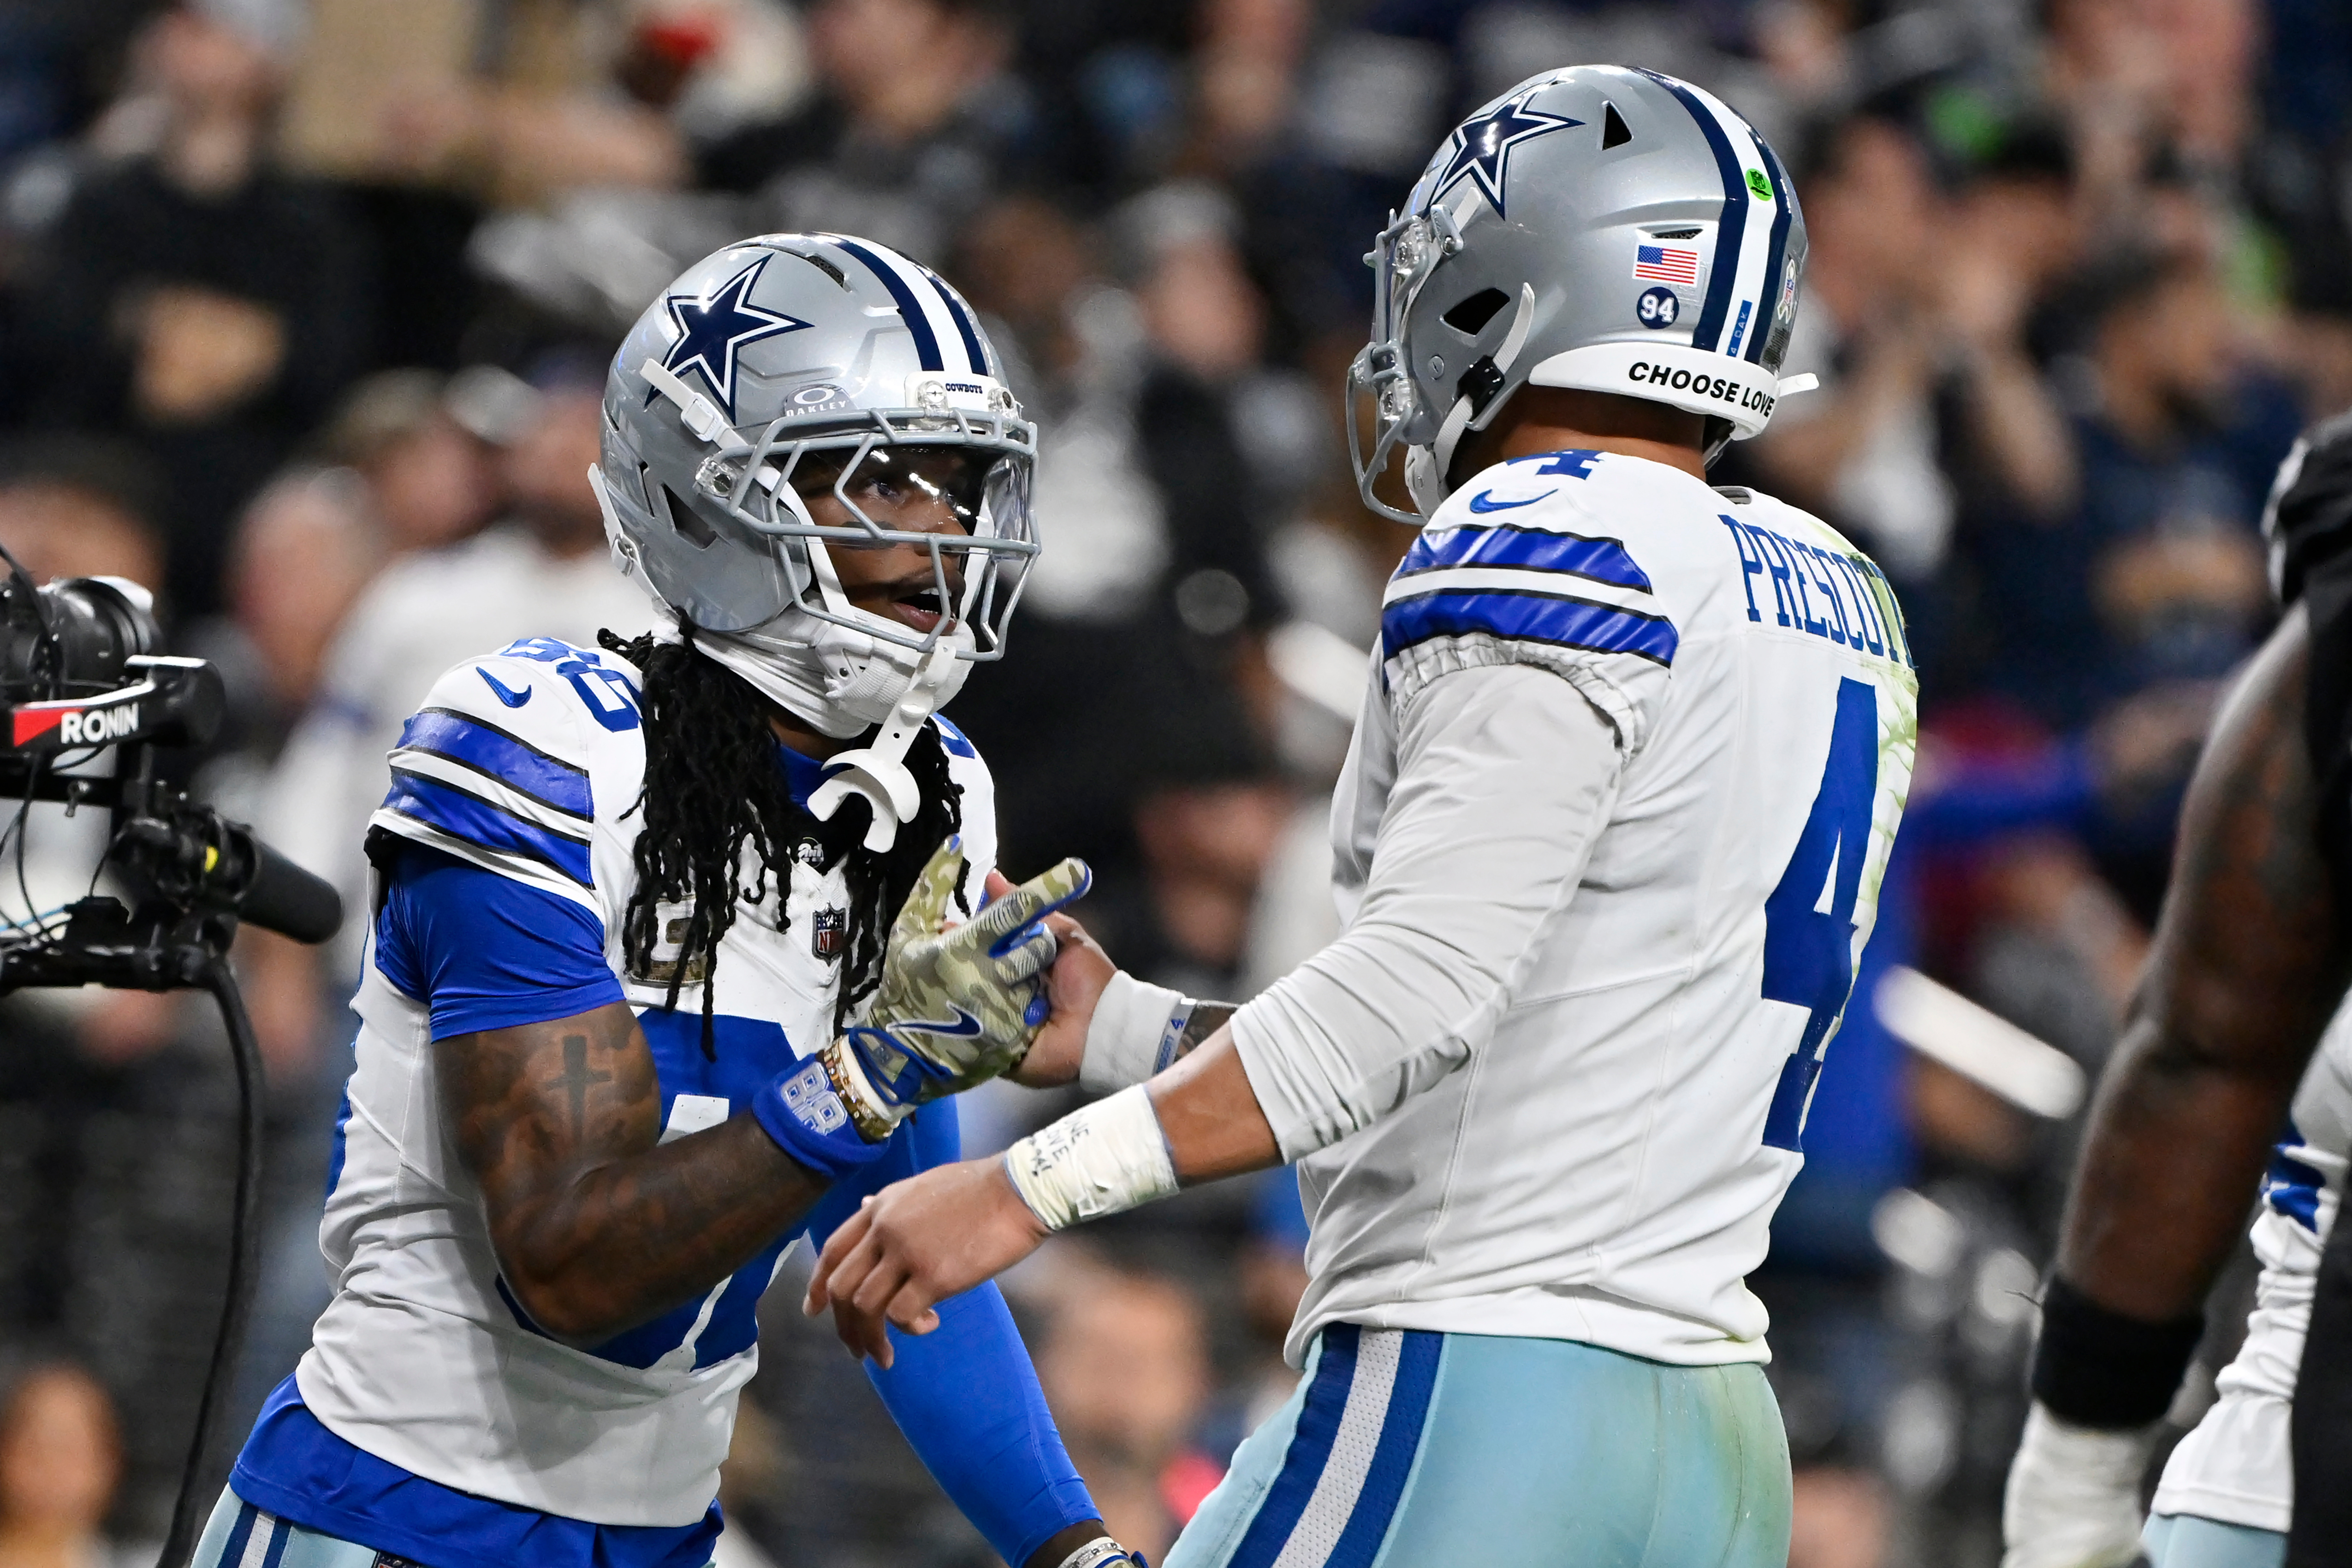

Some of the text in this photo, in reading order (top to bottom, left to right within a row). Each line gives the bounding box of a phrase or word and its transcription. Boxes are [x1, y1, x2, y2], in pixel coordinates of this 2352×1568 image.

[1640, 294, 1675, 323] 94
[1734, 312, 1748, 338] DAK
[786, 400, 847, 417] OAKLEY
[945, 383, 983, 394] COWBOYS
[1628, 361, 1775, 418] CHOOSE LOVE
[1717, 514, 1917, 669] PRESCOTT
[60, 701, 139, 744] RONIN
[1760, 675, 1879, 1153] 4
[780, 1061, 848, 1136] 88
